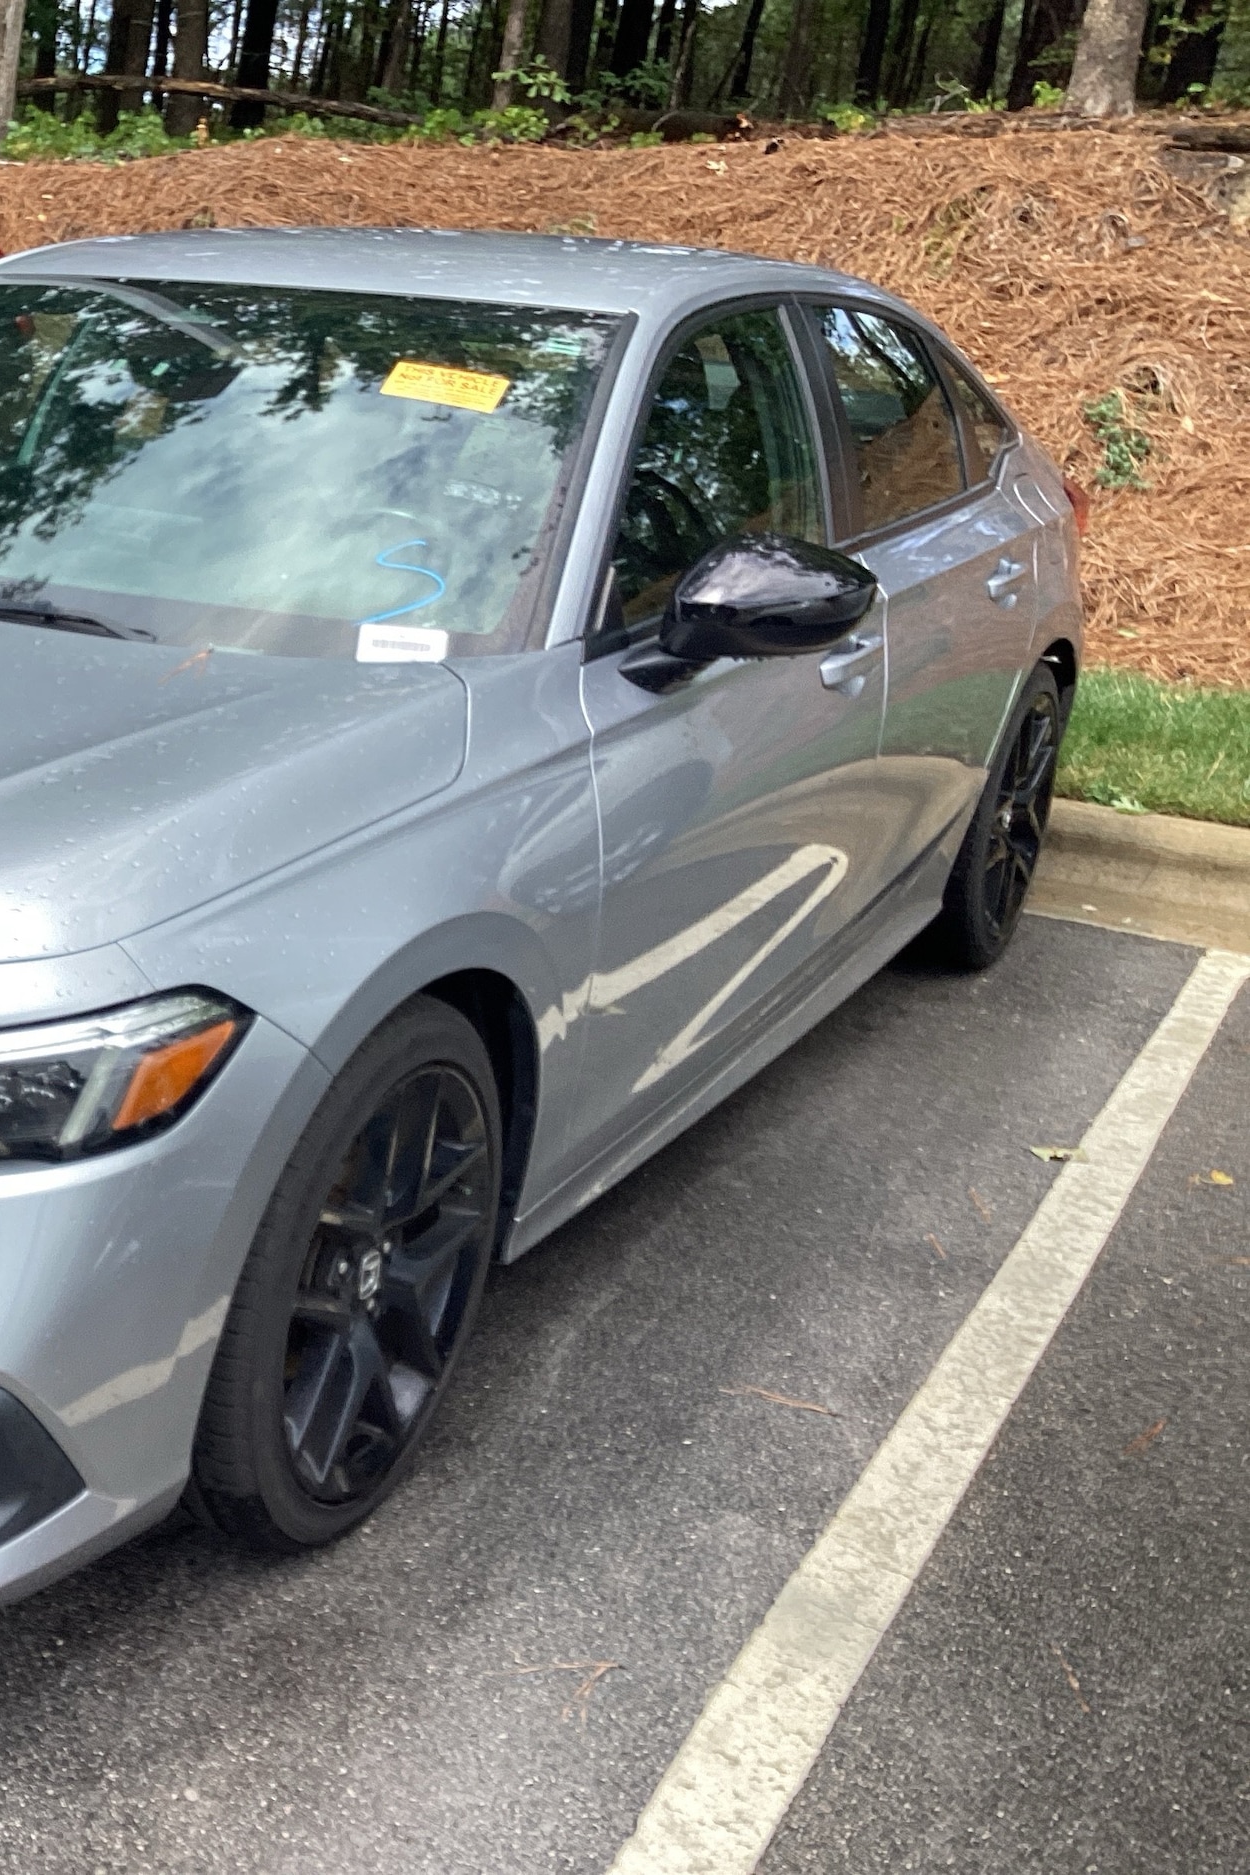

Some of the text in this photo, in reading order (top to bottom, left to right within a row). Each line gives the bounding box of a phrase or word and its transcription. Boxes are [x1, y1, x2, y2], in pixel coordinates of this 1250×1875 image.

[405, 365, 500, 387] THIS VEHICLE
[427, 376, 456, 387] FOR
[460, 382, 497, 396] SALE
